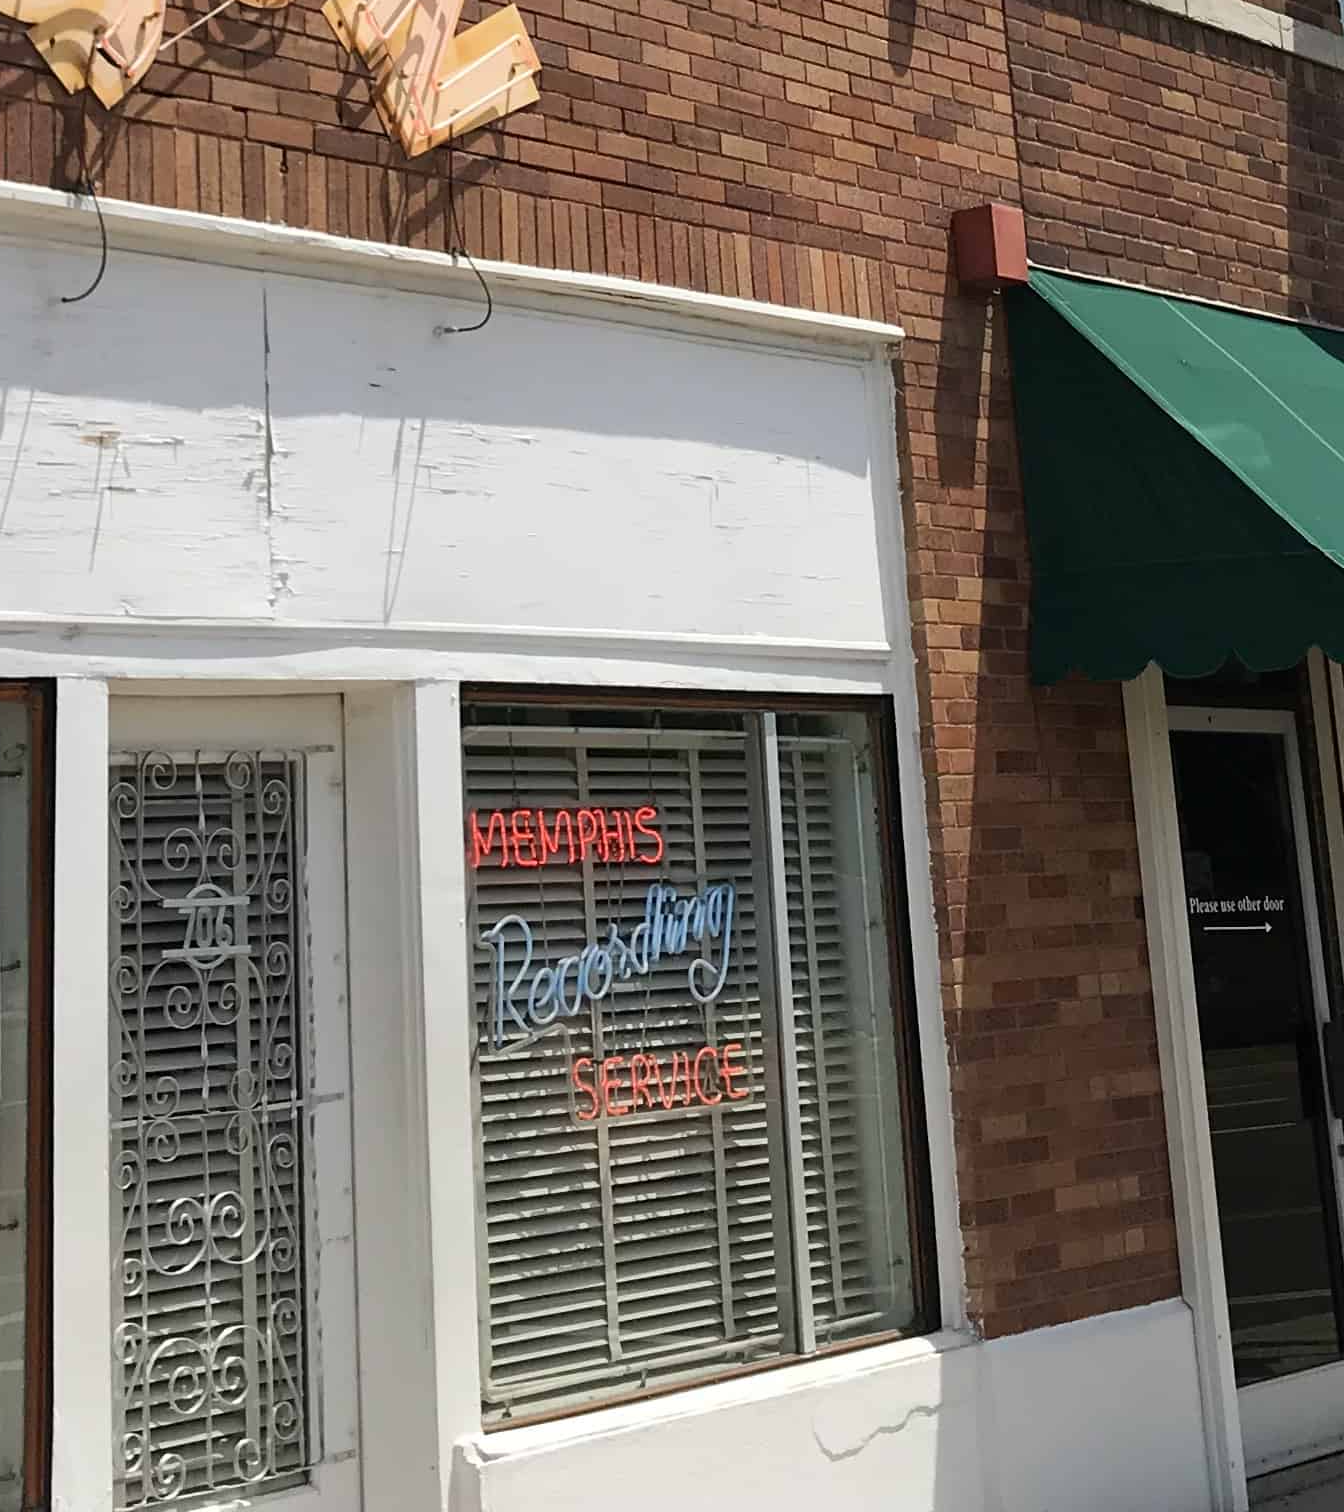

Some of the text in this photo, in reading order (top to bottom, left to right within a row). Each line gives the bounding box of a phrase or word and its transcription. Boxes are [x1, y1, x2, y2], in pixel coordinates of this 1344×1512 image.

[469, 806, 664, 868] MEMPHIS
[177, 906, 234, 948] 706
[1189, 895, 1285, 914] Please use other door
[480, 883, 736, 1048] Recording
[572, 1043, 749, 1121] SERVICE
